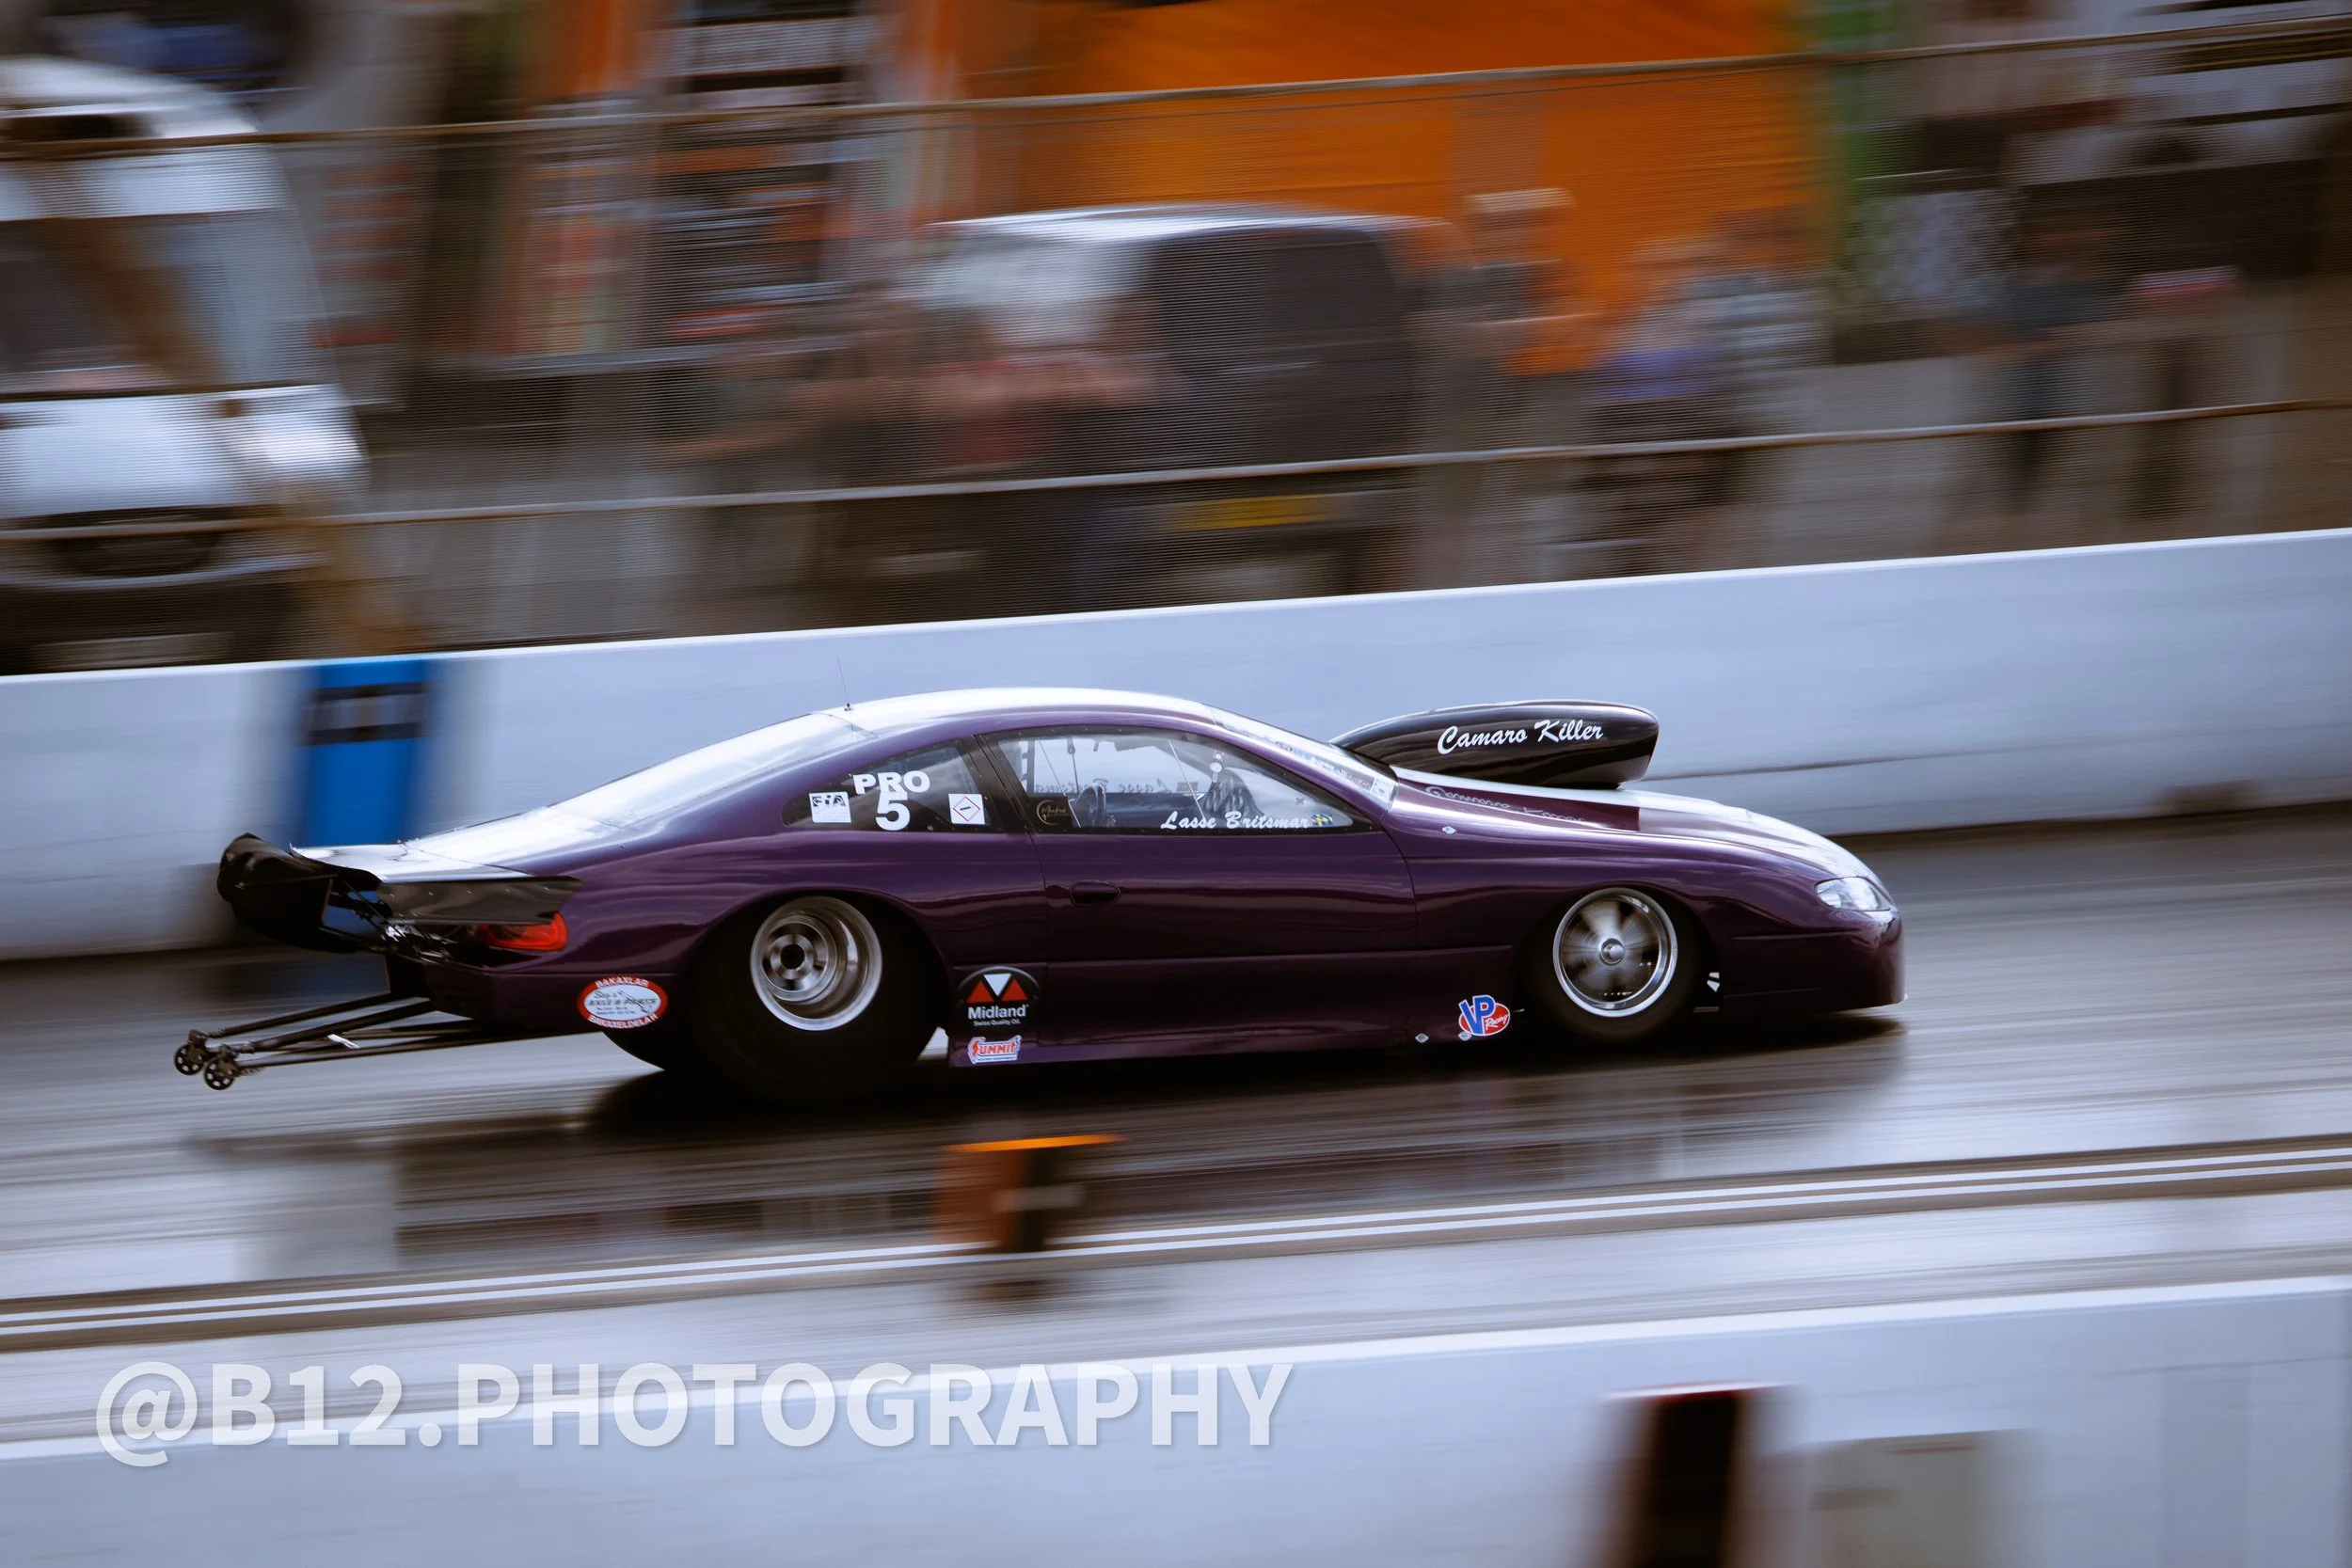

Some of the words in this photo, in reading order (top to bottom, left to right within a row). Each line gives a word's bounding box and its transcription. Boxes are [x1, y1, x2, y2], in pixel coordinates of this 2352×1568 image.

[1438, 725, 1528, 755] Camaro
[1534, 719, 1604, 743] Killer
[852, 769, 930, 795] PRO
[875, 791, 911, 832] 5
[1160, 810, 1217, 830] Lasse
[968, 1005, 1026, 1019] Midland
[1458, 994, 1496, 1036] VP
